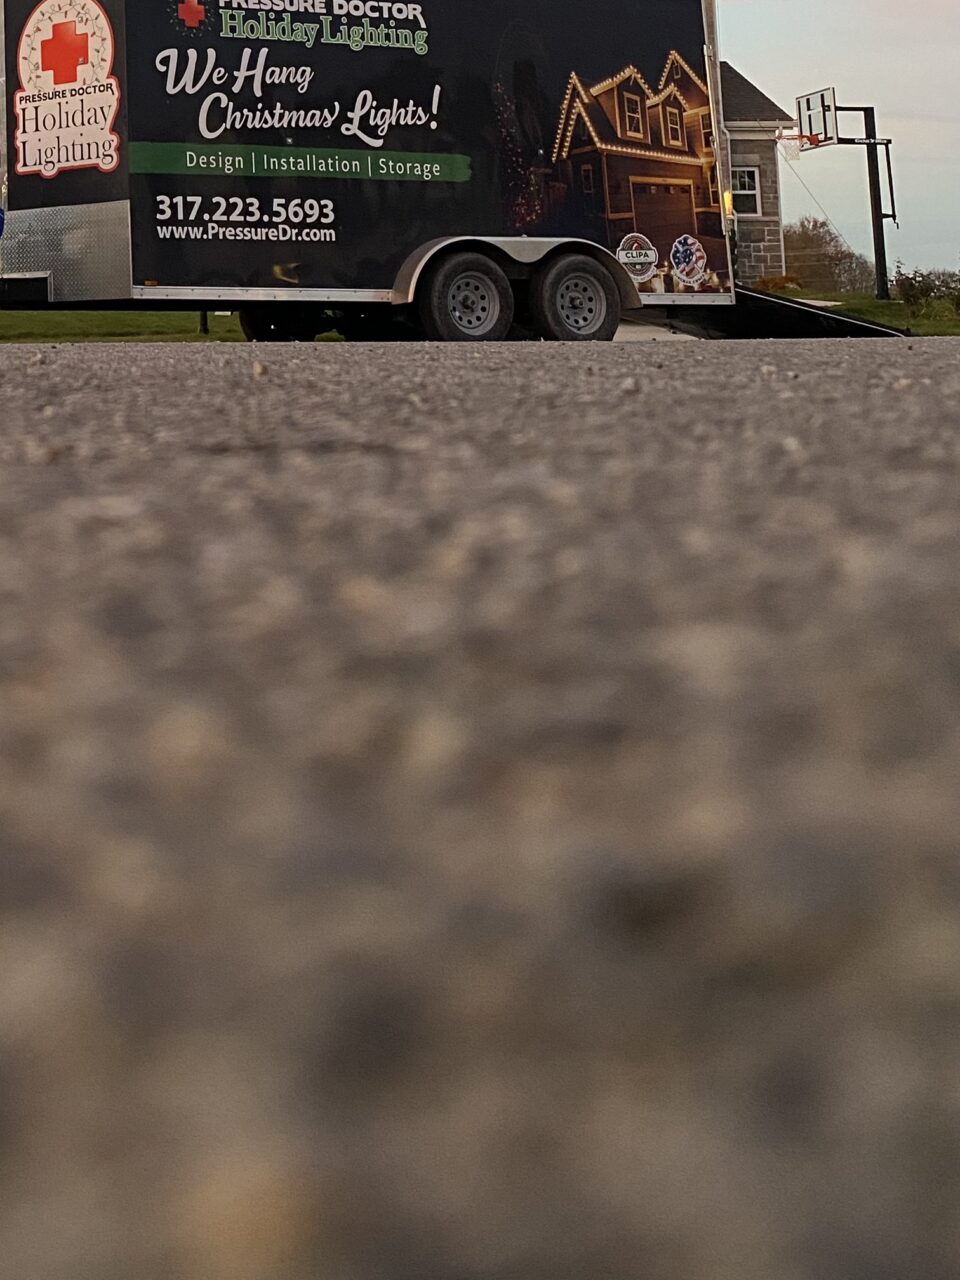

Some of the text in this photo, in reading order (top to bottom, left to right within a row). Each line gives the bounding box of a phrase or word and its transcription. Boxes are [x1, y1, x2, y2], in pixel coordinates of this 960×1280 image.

[218, 9, 429, 55] Holiday Lighting
[155, 47, 315, 97] We Hang
[19, 82, 115, 105] PRESSURE DOCTOR
[20, 99, 112, 134] Holiday
[198, 84, 442, 148] Christmas Lights!
[21, 132, 115, 172] Lighting
[186, 151, 442, 180] Design Installation Storage
[156, 195, 335, 223] 317.223.5693
[156, 223, 336, 242] www.PressureDr.com
[625, 251, 650, 259] CLIPA
